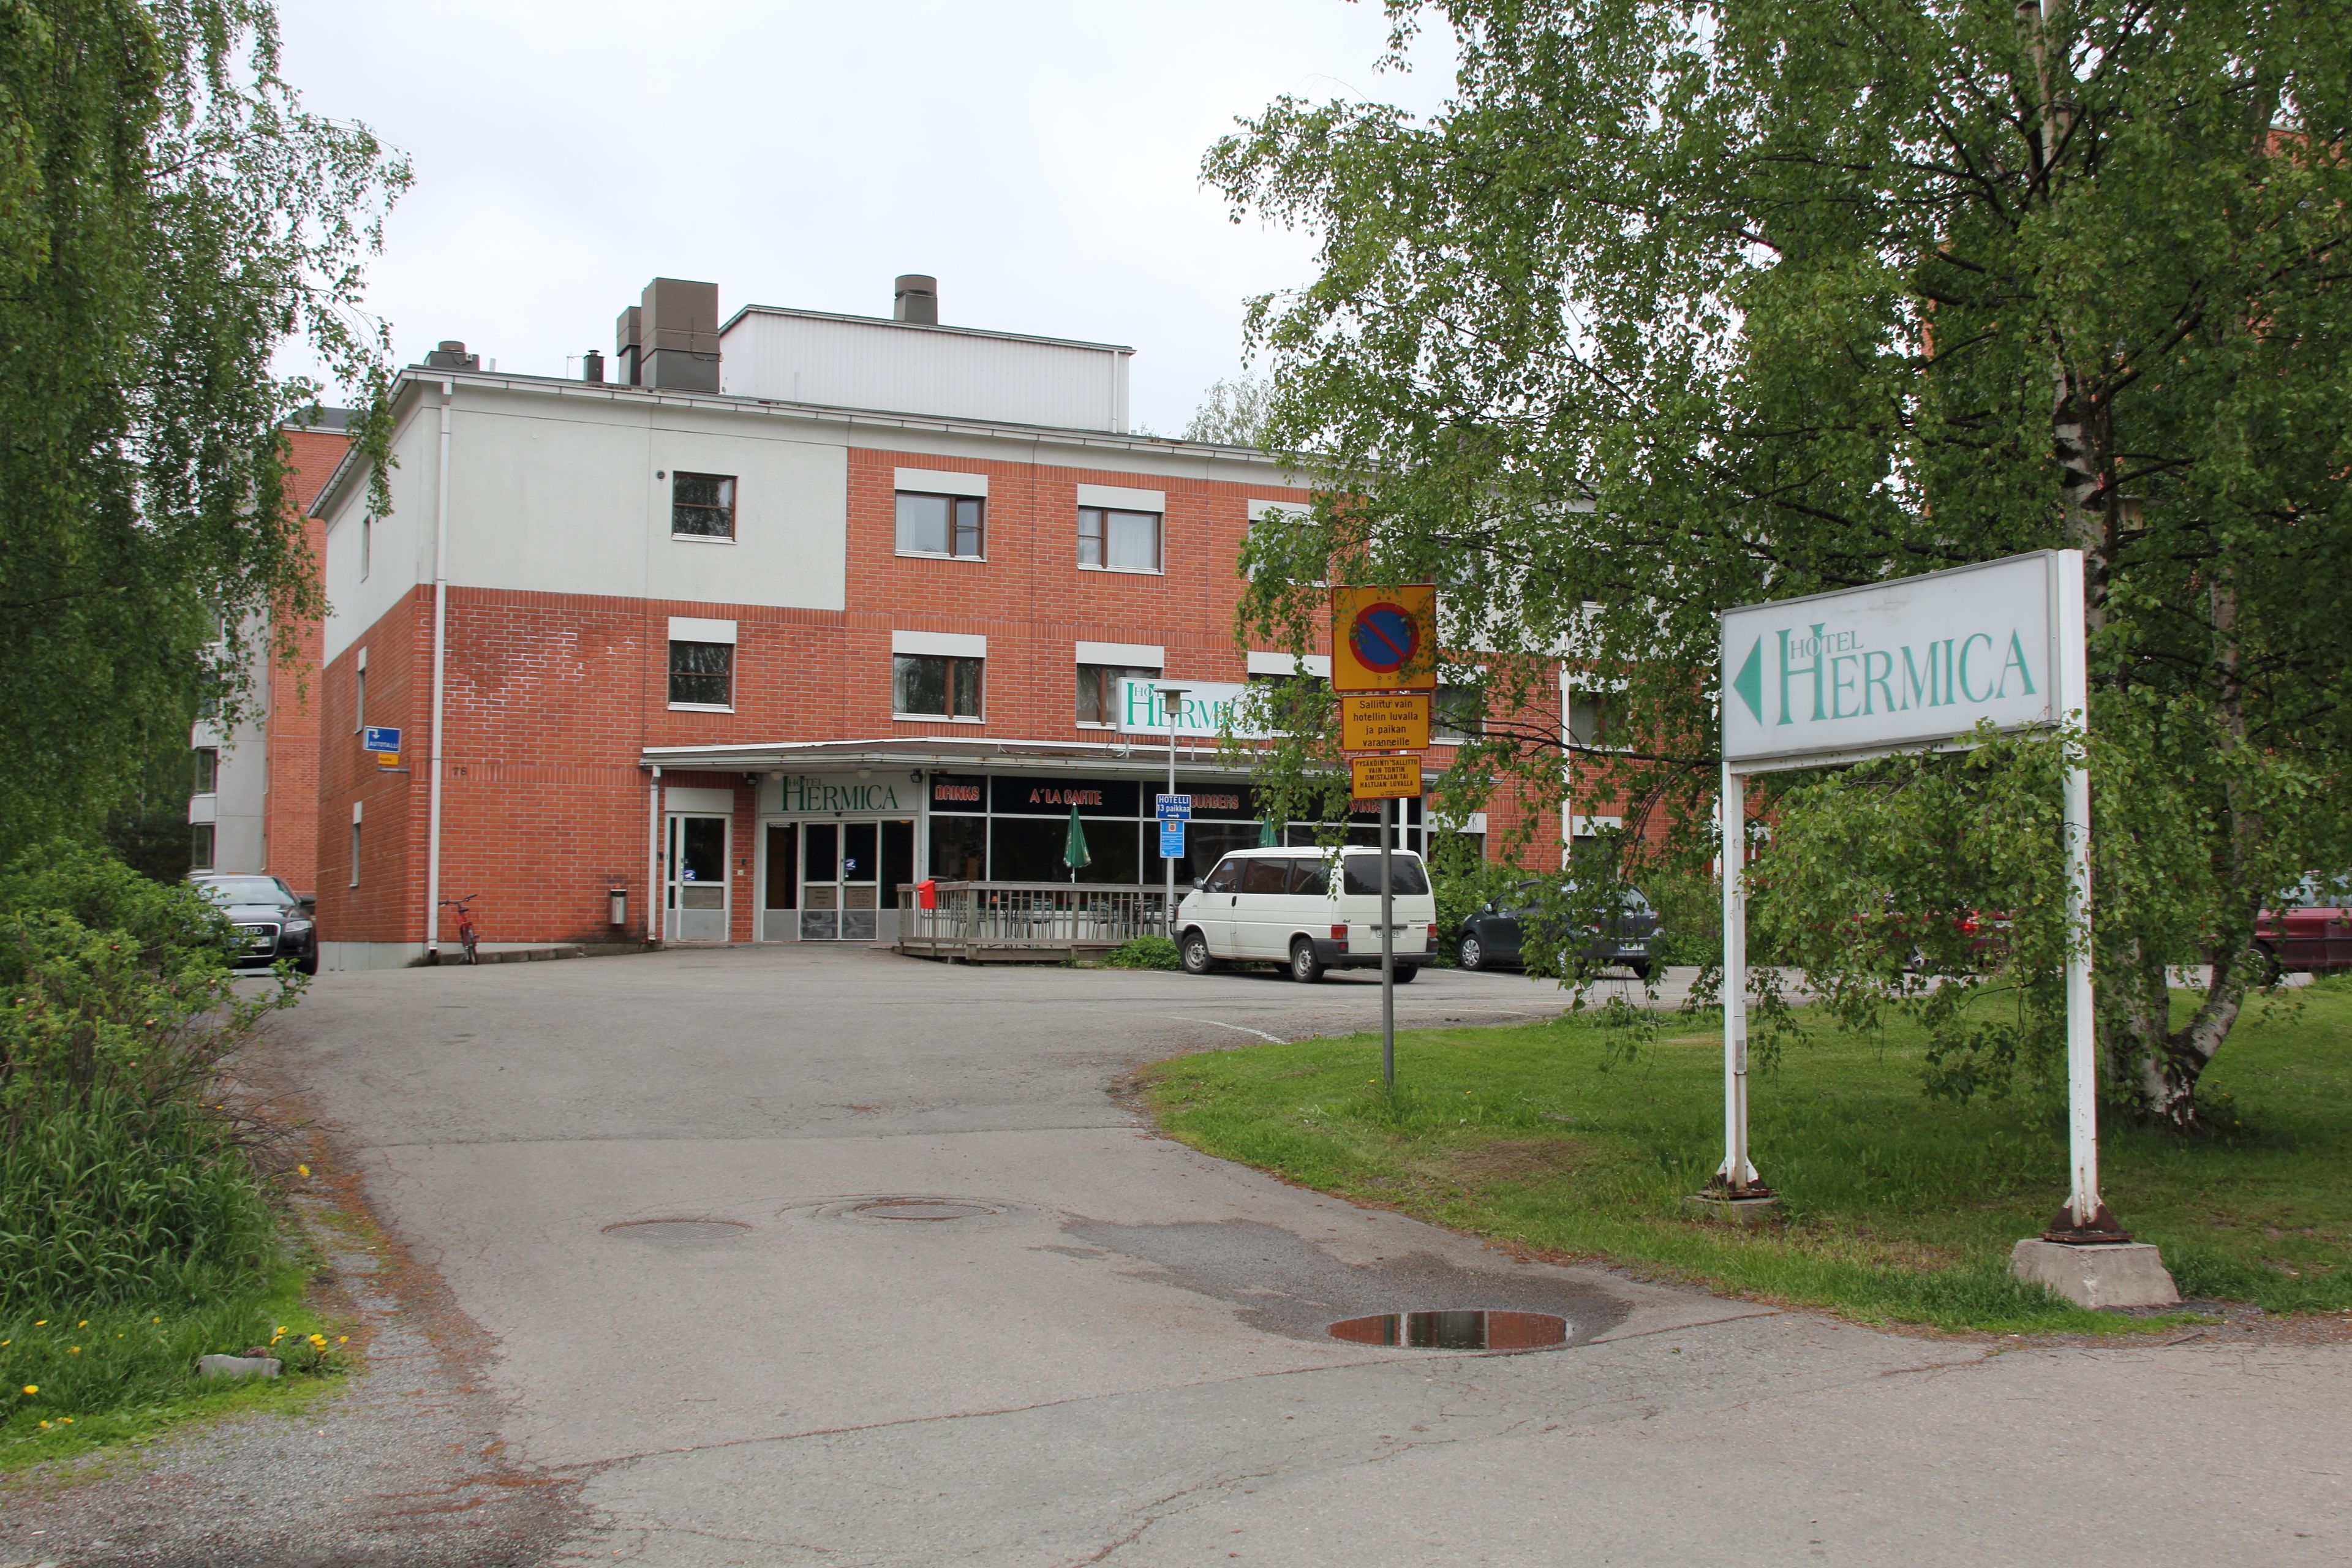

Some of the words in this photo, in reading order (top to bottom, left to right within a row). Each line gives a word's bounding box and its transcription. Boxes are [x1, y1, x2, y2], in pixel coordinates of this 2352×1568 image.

[1790, 630, 1864, 660] HOTEL
[1776, 622, 2037, 726] HERMICA
[1360, 699, 1392, 709] Sallittu
[1395, 699, 1412, 708] vain
[1354, 712, 1385, 722] hotellin
[1390, 712, 1419, 721] luvalla
[1366, 726, 1374, 735] ja
[1378, 725, 1406, 735] paikan
[1363, 737, 1410, 747] varanneille
[788, 778, 824, 787] HOTEL
[782, 775, 899, 811] HERMICA
[935, 785, 980, 801] DRINKS
[1064, 789, 1103, 805] CARTE
[1159, 796, 1189, 804] HOTELLI
[1166, 804, 1190, 813] paikkaa
